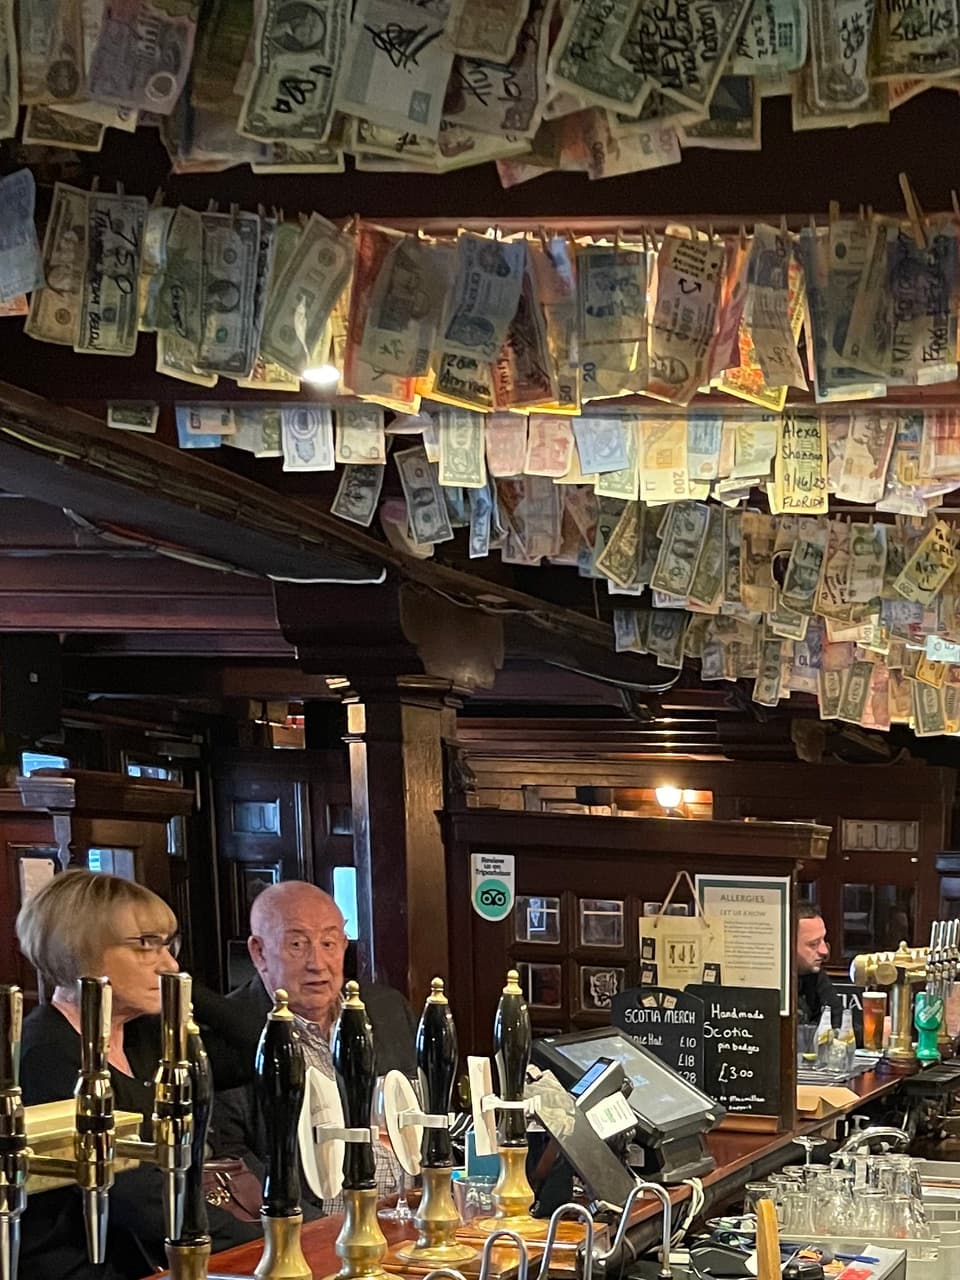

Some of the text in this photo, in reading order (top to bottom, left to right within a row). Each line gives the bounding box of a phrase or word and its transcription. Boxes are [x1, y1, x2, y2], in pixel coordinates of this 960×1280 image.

[582, 361, 597, 384] 20
[782, 424, 822, 440] Alexa
[673, 470, 686, 495] 200
[782, 496, 826, 510] FLORIDA
[719, 893, 766, 904] ALLERGIES
[719, 909, 768, 918] LET US KNOW
[624, 1009, 696, 1025] SCOTIA MERCH
[711, 1003, 765, 1020] Handmade
[704, 1021, 753, 1039] Scotia
[680, 1036, 697, 1049] £10
[718, 1042, 760, 1055] pin badges
[678, 1053, 695, 1067] £18
[679, 1071, 697, 1085] 28
